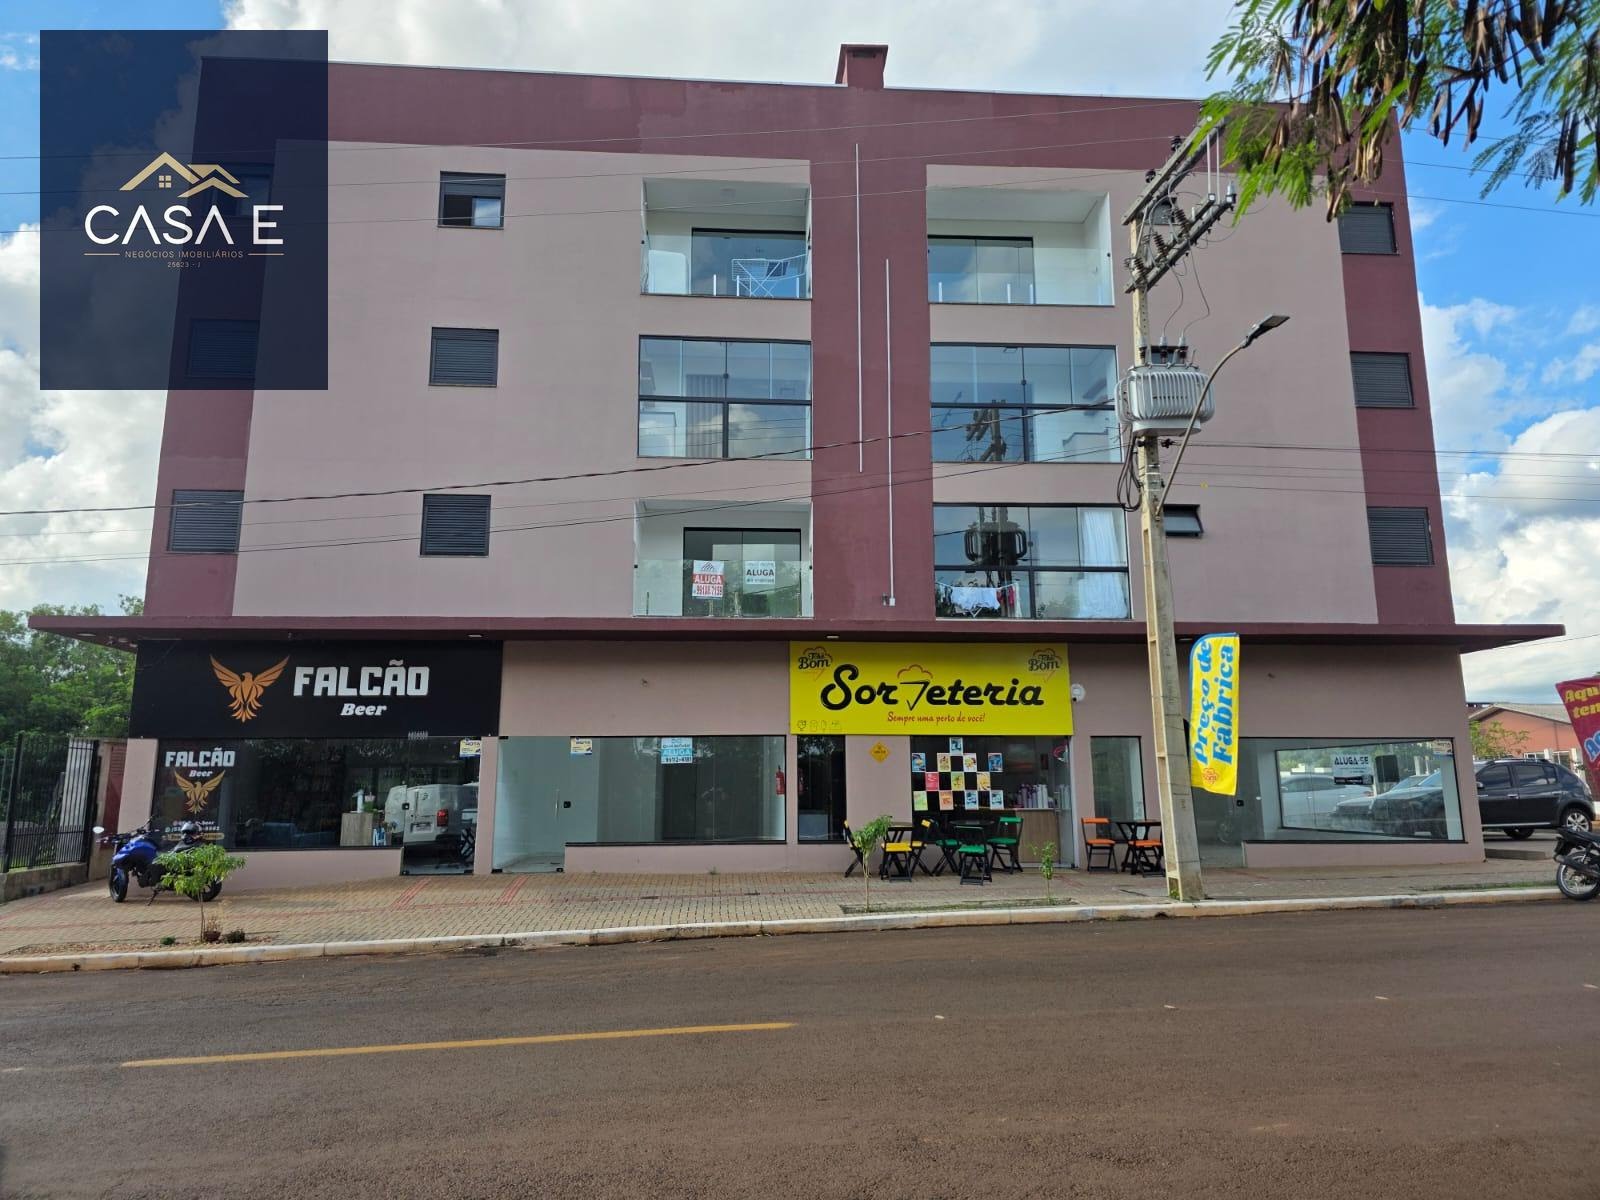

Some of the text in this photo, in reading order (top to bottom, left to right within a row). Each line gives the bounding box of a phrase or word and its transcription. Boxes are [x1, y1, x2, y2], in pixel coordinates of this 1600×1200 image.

[694, 575, 722, 584] ALUGA
[746, 569, 775, 577] ALUGA
[798, 656, 832, 670] Bom
[1196, 640, 1213, 673] de
[1028, 658, 1061, 671] Bom
[293, 659, 430, 696] FALCÃO
[340, 703, 387, 717] Beer
[1212, 645, 1234, 765] Fábrica
[887, 711, 915, 726] Sempre
[917, 715, 934, 723] uma
[936, 714, 955, 726] perto
[957, 711, 966, 722] de
[1194, 678, 1214, 765] Preço
[165, 747, 236, 767] FALCÃO
[1334, 756, 1369, 765] ALUGA-SE
